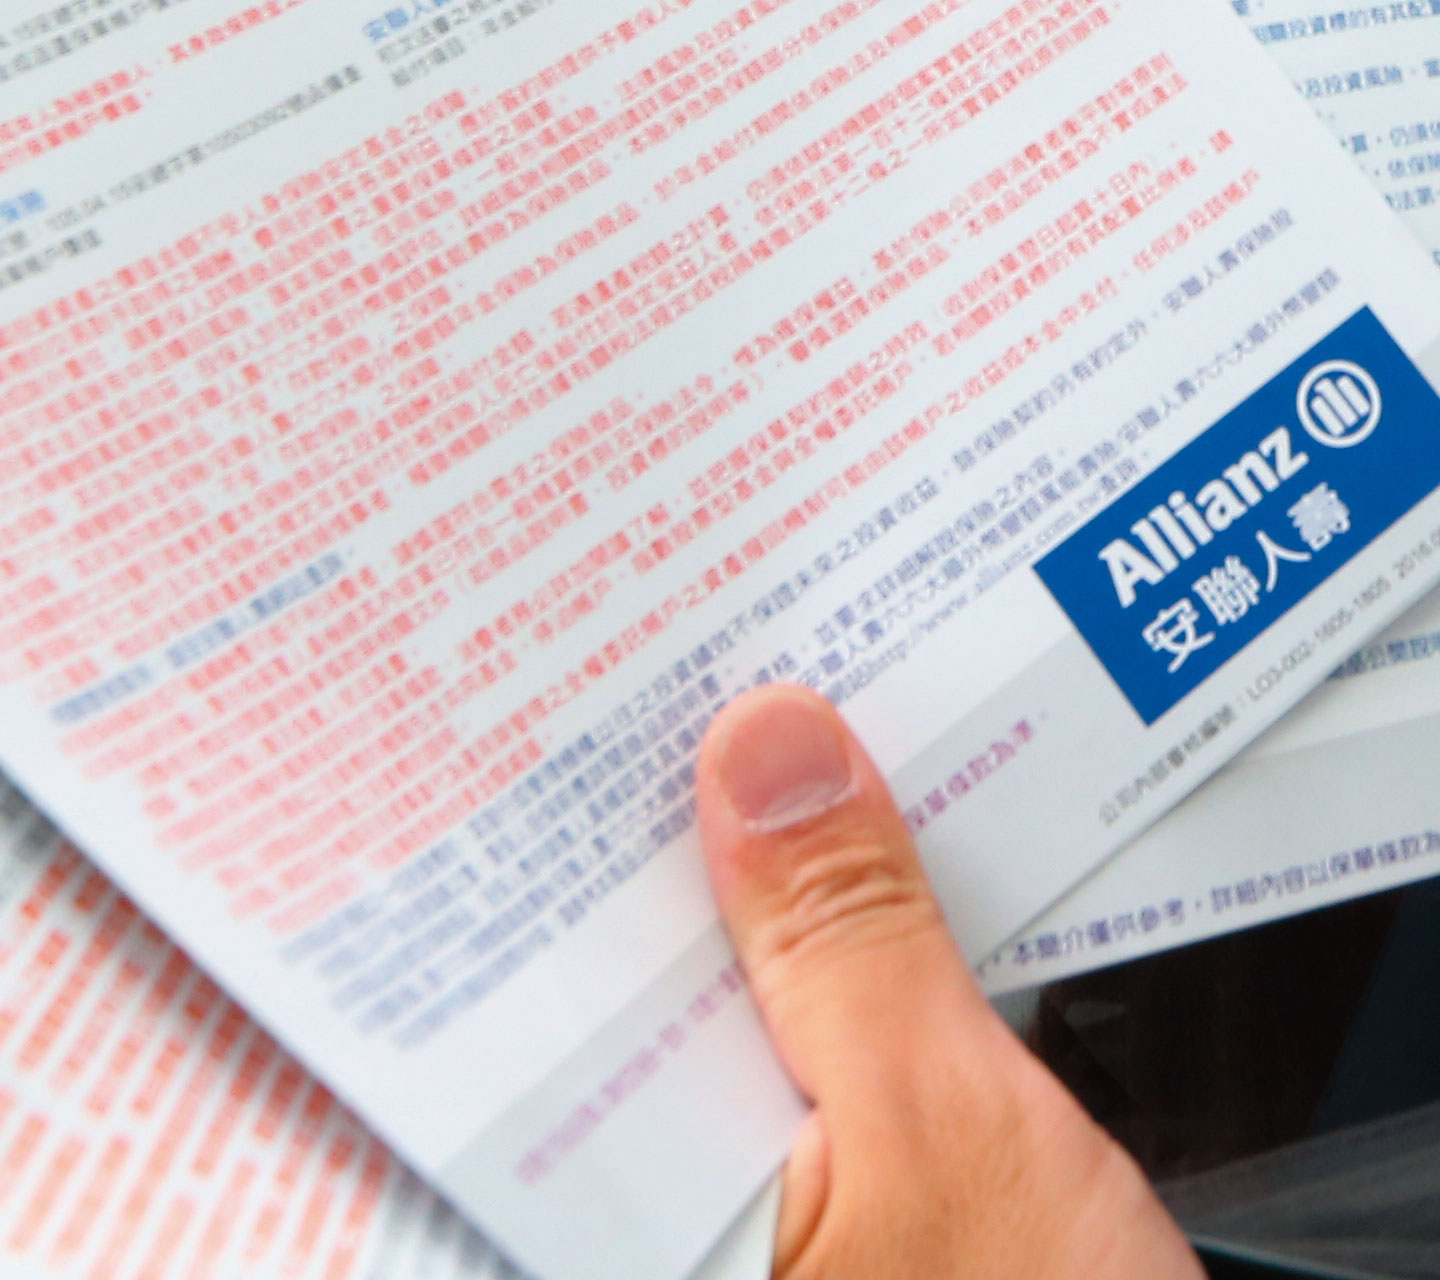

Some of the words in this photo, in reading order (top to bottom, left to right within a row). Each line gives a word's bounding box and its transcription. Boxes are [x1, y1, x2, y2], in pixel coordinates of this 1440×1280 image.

[1097, 426, 1310, 608] Allianz
[1142, 483, 1353, 673] 安聯人壽
